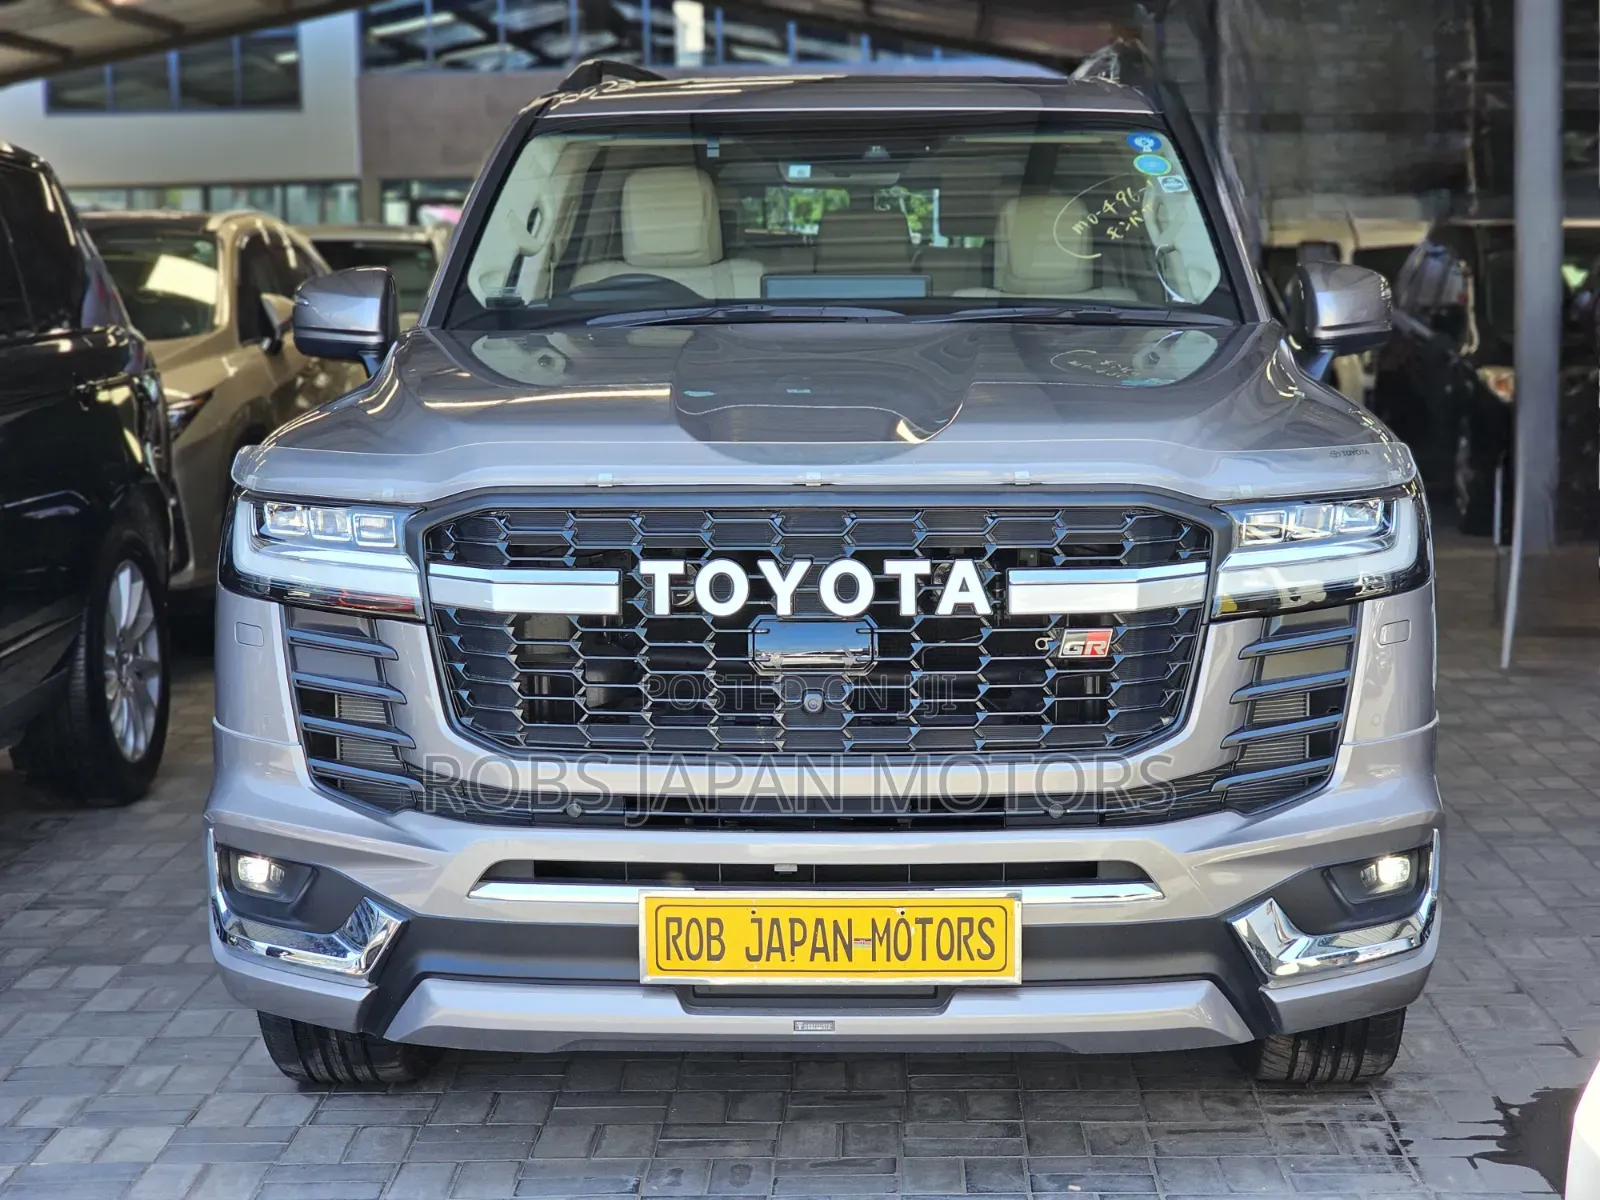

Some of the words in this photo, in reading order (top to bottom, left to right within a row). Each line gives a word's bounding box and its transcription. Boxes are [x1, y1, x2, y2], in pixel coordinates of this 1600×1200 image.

[1341, 449, 1370, 457] TOYOTA
[639, 557, 994, 617] TOYOTA
[1062, 640, 1107, 655] GR
[665, 917, 726, 961] ROB
[745, 917, 853, 963] JAPAN
[871, 917, 996, 963] MOTORS
